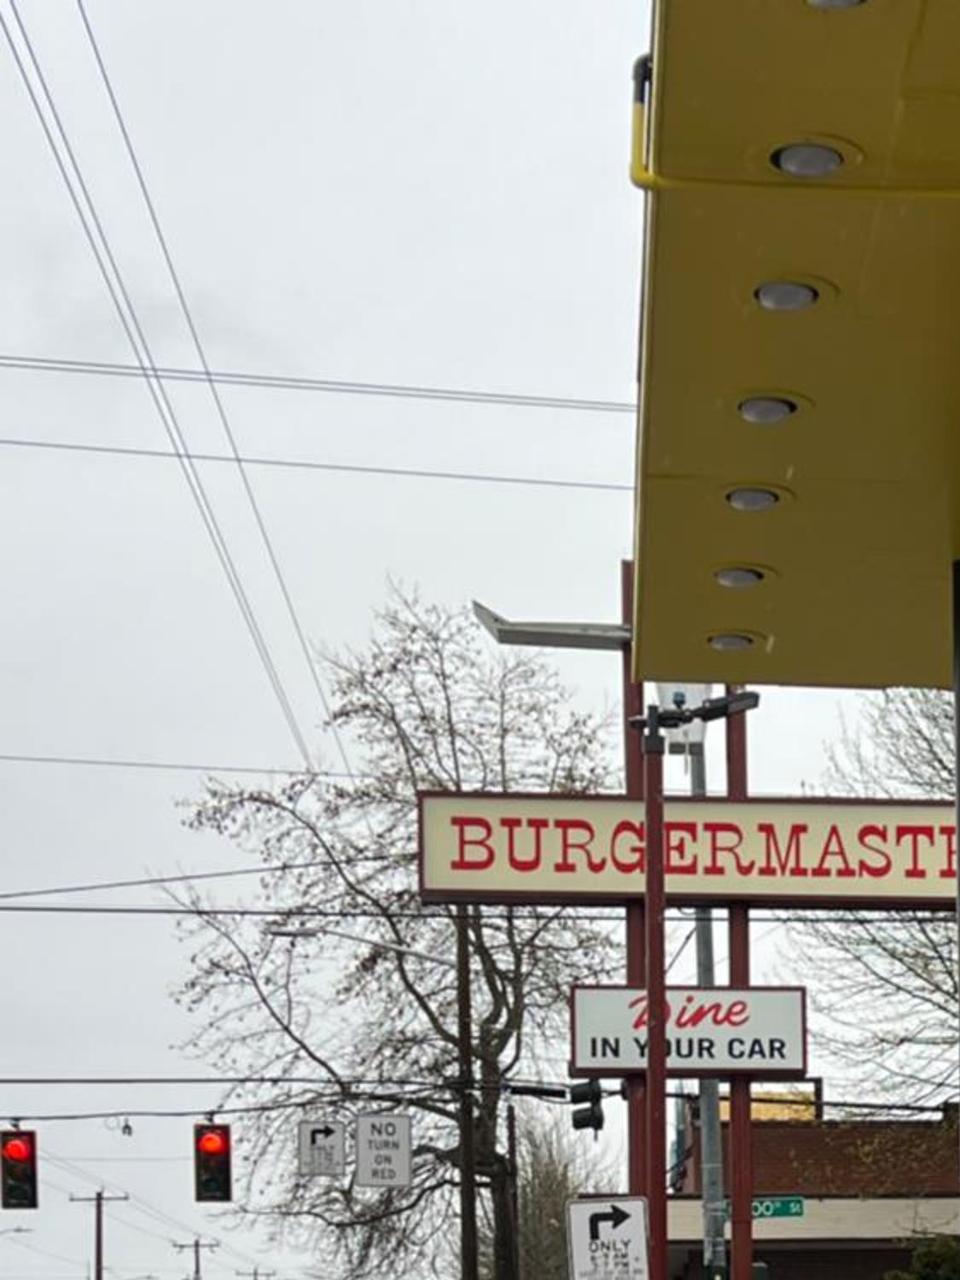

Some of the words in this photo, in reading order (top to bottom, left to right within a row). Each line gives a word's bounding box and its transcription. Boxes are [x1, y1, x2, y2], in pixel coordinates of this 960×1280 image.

[590, 1037, 621, 1058] IN
[633, 1037, 715, 1059] YUR
[727, 1038, 786, 1060] CAR
[371, 1122, 396, 1136] NO
[368, 1139, 399, 1150] TURN
[374, 1154, 392, 1165] ON
[371, 1168, 396, 1180] RED
[588, 1238, 631, 1253] ONLY
